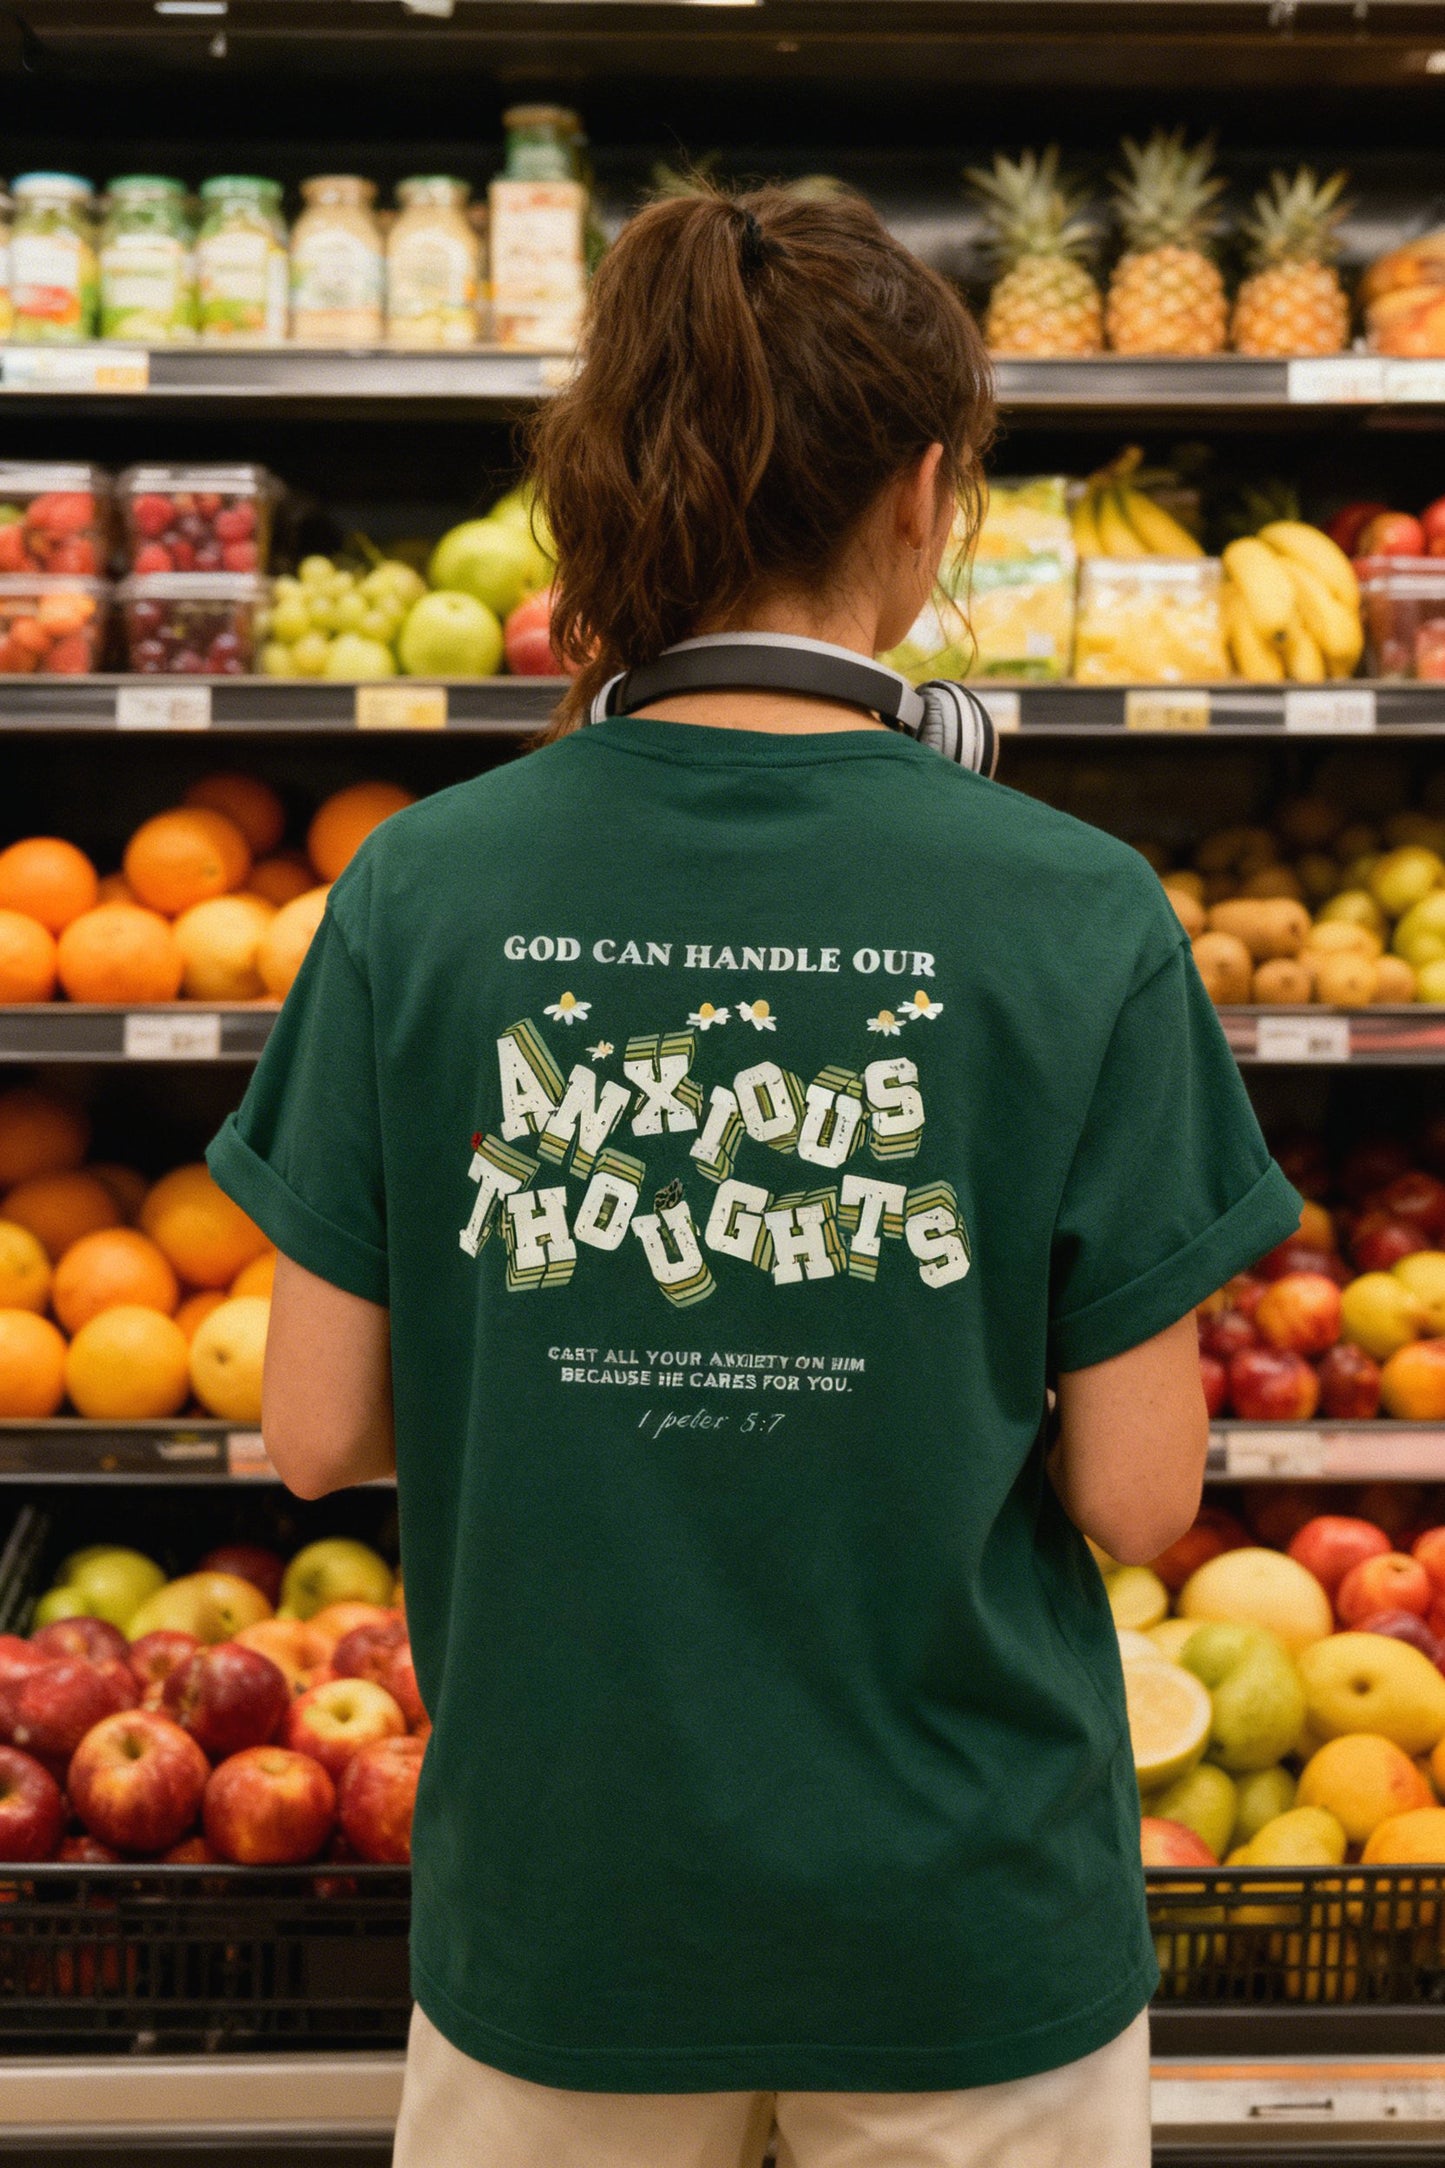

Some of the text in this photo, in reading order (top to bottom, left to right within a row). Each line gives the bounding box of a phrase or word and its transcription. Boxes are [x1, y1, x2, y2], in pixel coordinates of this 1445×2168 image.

[503, 934, 937, 978] GOD CAN HANDLE OUR
[495, 1019, 928, 1181] ANXIOUS
[457, 1136, 973, 1306] THOUGHTS
[603, 1349, 640, 1364] ALL
[645, 1350, 703, 1367] YOUR
[708, 1351, 790, 1370] ANXIETY
[794, 1355, 826, 1370] ON
[831, 1356, 867, 1373] HIM
[560, 1366, 854, 1393] BECAUSE HE CARES FOR YOU.
[739, 1411, 786, 1434] 5:7
